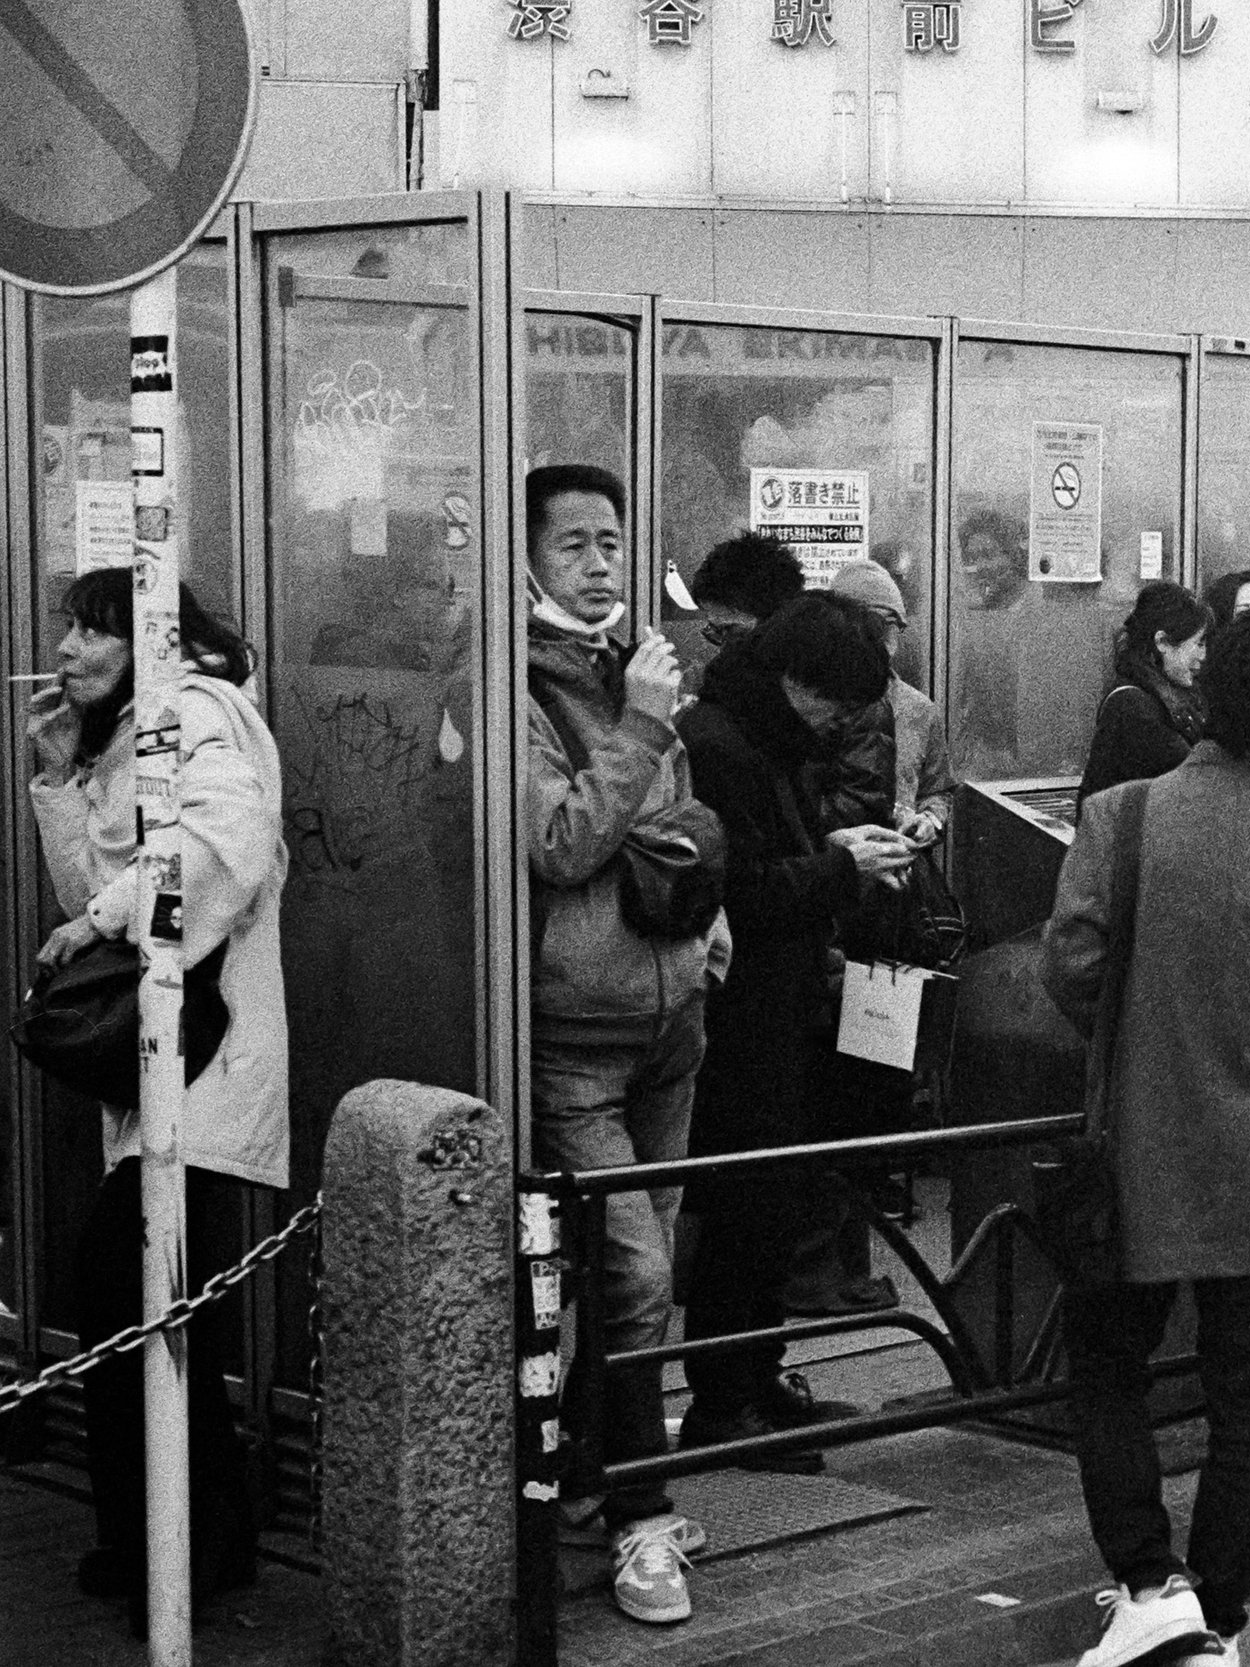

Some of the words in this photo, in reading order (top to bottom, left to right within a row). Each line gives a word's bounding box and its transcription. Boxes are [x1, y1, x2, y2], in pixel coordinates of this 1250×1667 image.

[787, 480, 860, 505] 落書き禁止
